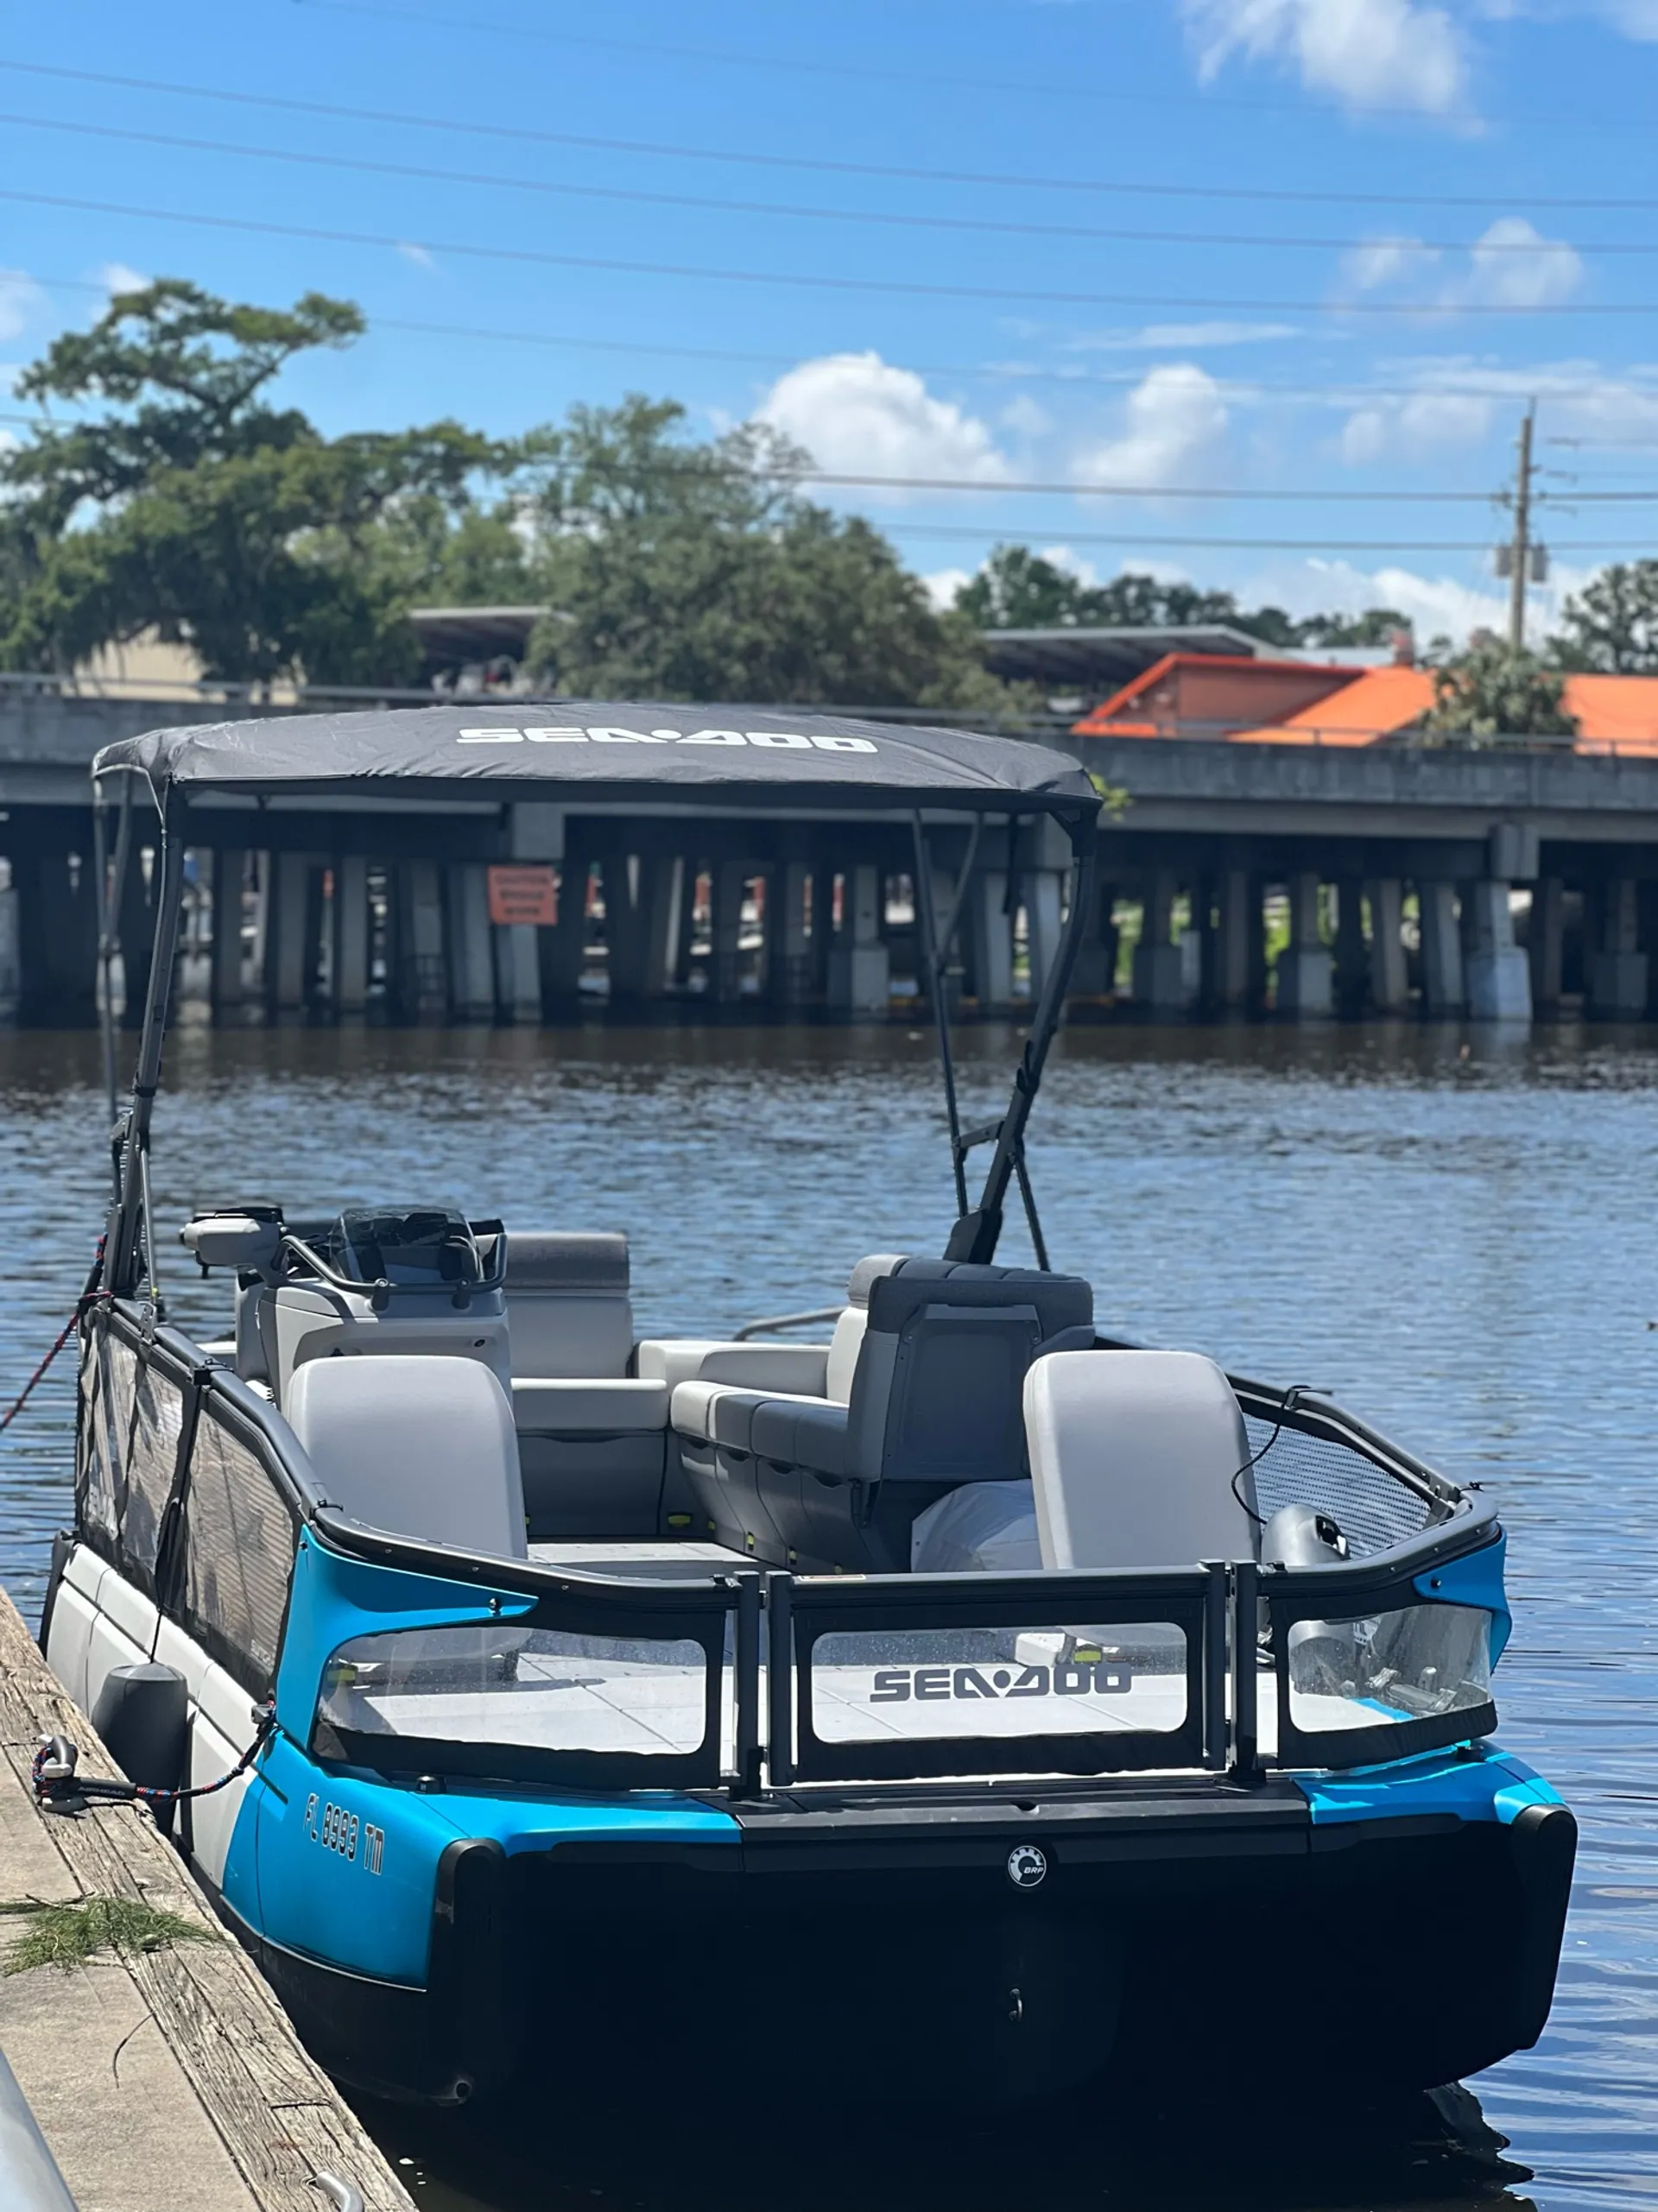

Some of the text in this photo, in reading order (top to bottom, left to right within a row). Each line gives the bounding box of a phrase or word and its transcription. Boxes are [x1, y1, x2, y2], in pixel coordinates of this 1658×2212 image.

[303, 1792, 385, 1876] FL 8993 TM
